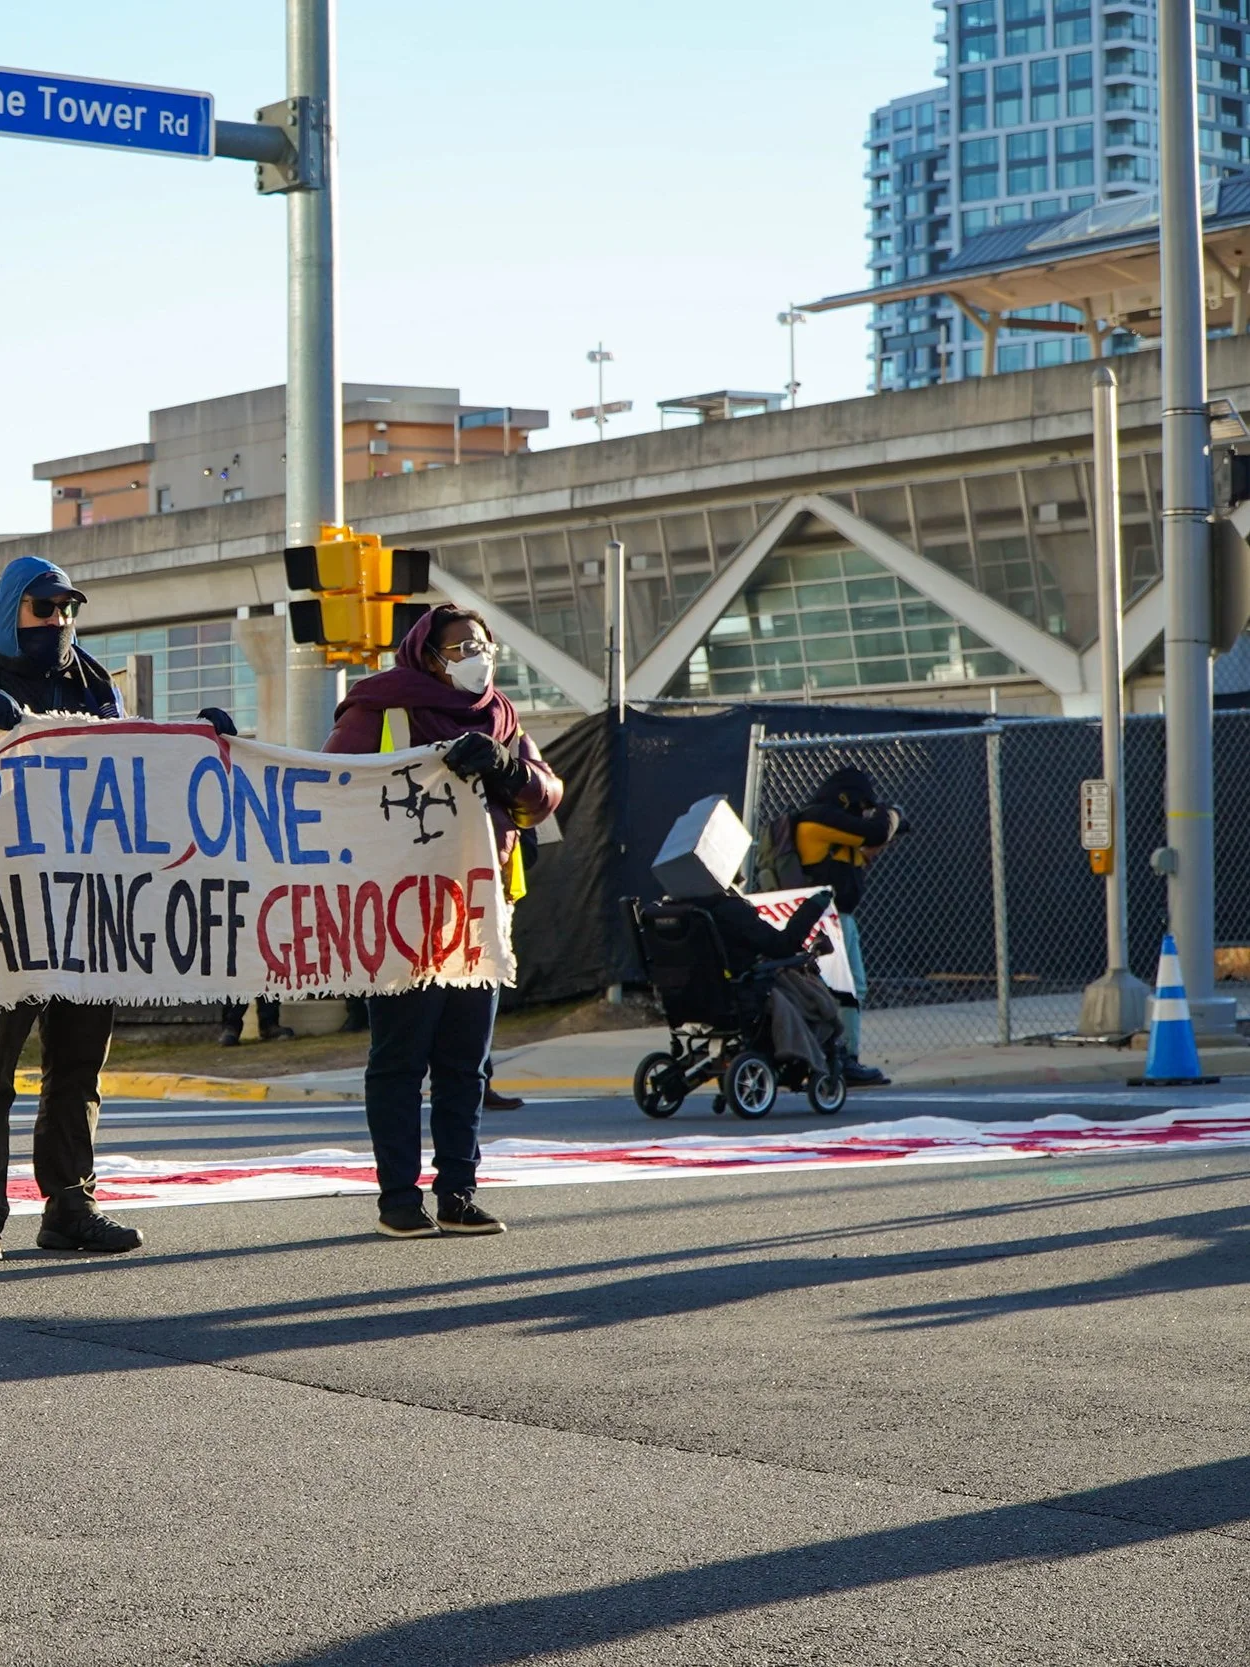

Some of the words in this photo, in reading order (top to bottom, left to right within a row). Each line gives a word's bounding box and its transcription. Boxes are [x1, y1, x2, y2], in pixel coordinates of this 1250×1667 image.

[37, 86, 147, 131] Tower
[159, 111, 189, 137] Rd
[187, 755, 353, 865] ONE:
[165, 878, 250, 977] OFF
[257, 868, 495, 991] GENOCIDE
